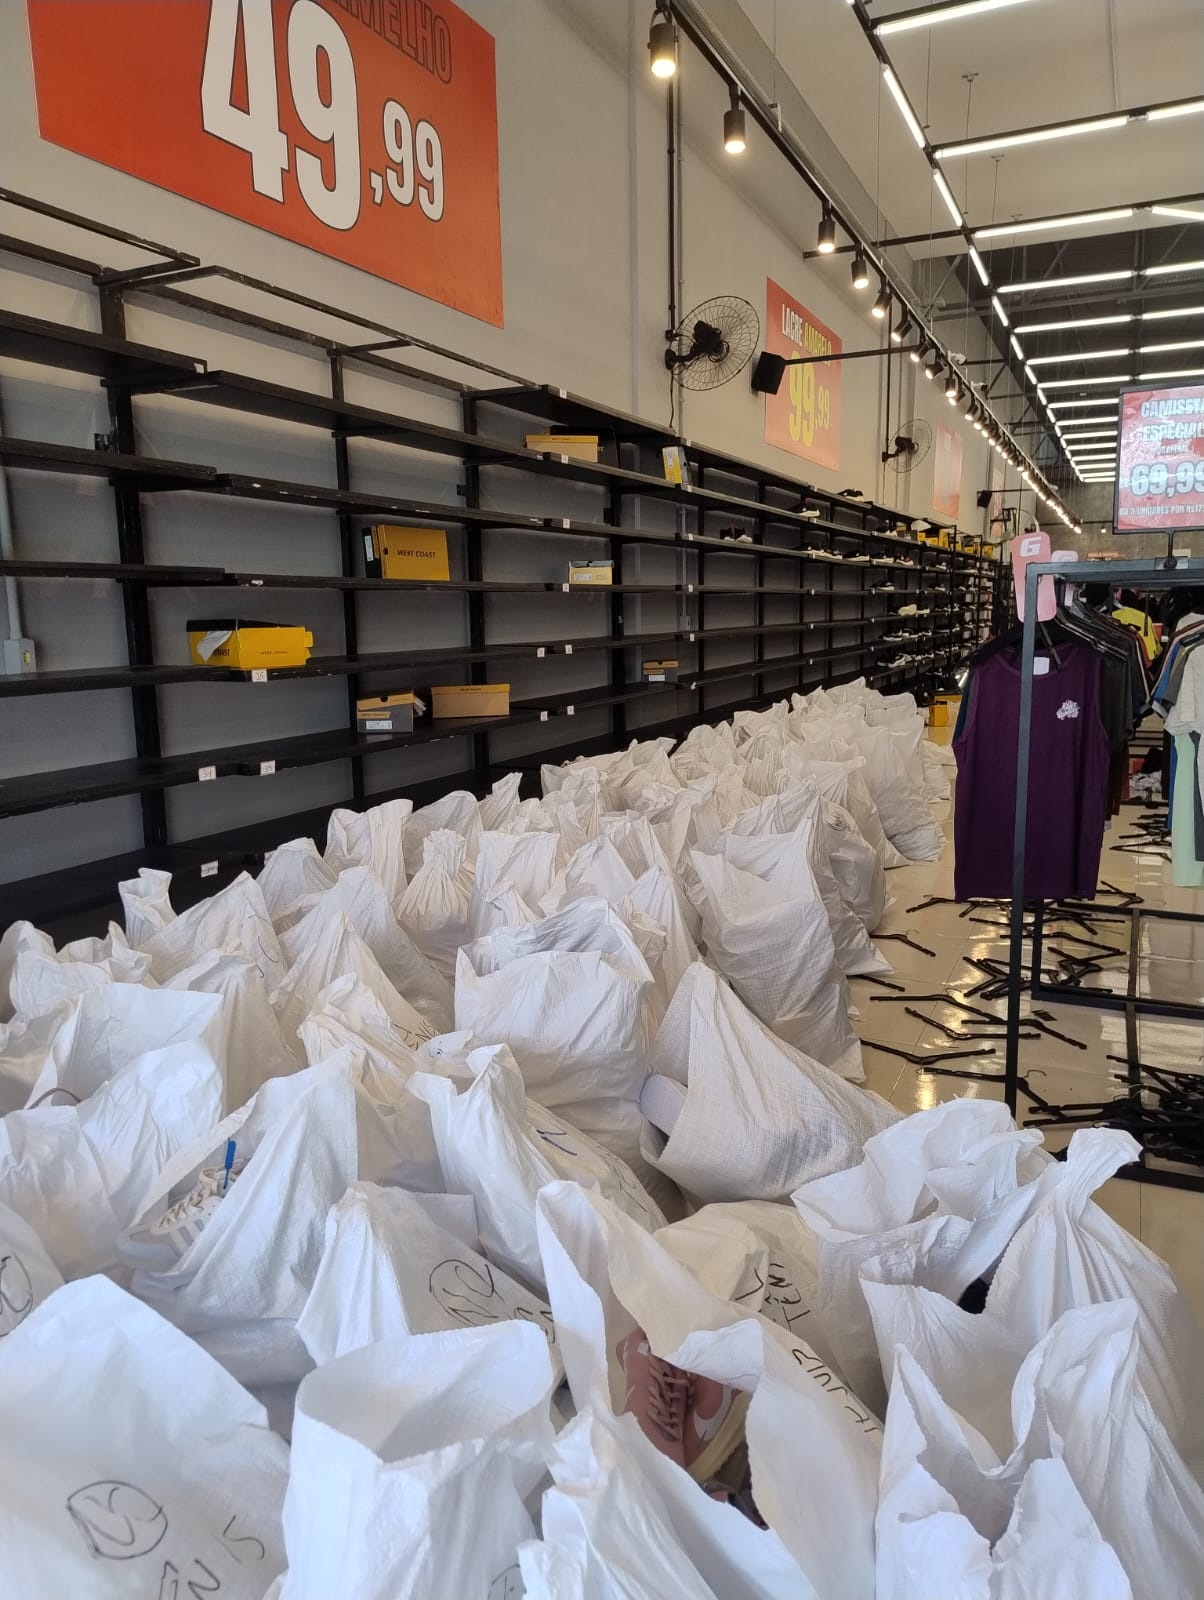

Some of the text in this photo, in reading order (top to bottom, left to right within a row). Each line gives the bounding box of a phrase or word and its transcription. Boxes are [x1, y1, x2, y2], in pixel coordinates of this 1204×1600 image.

[782, 303, 803, 347] LACRE
[397, 549, 436, 558] WEST COAST
